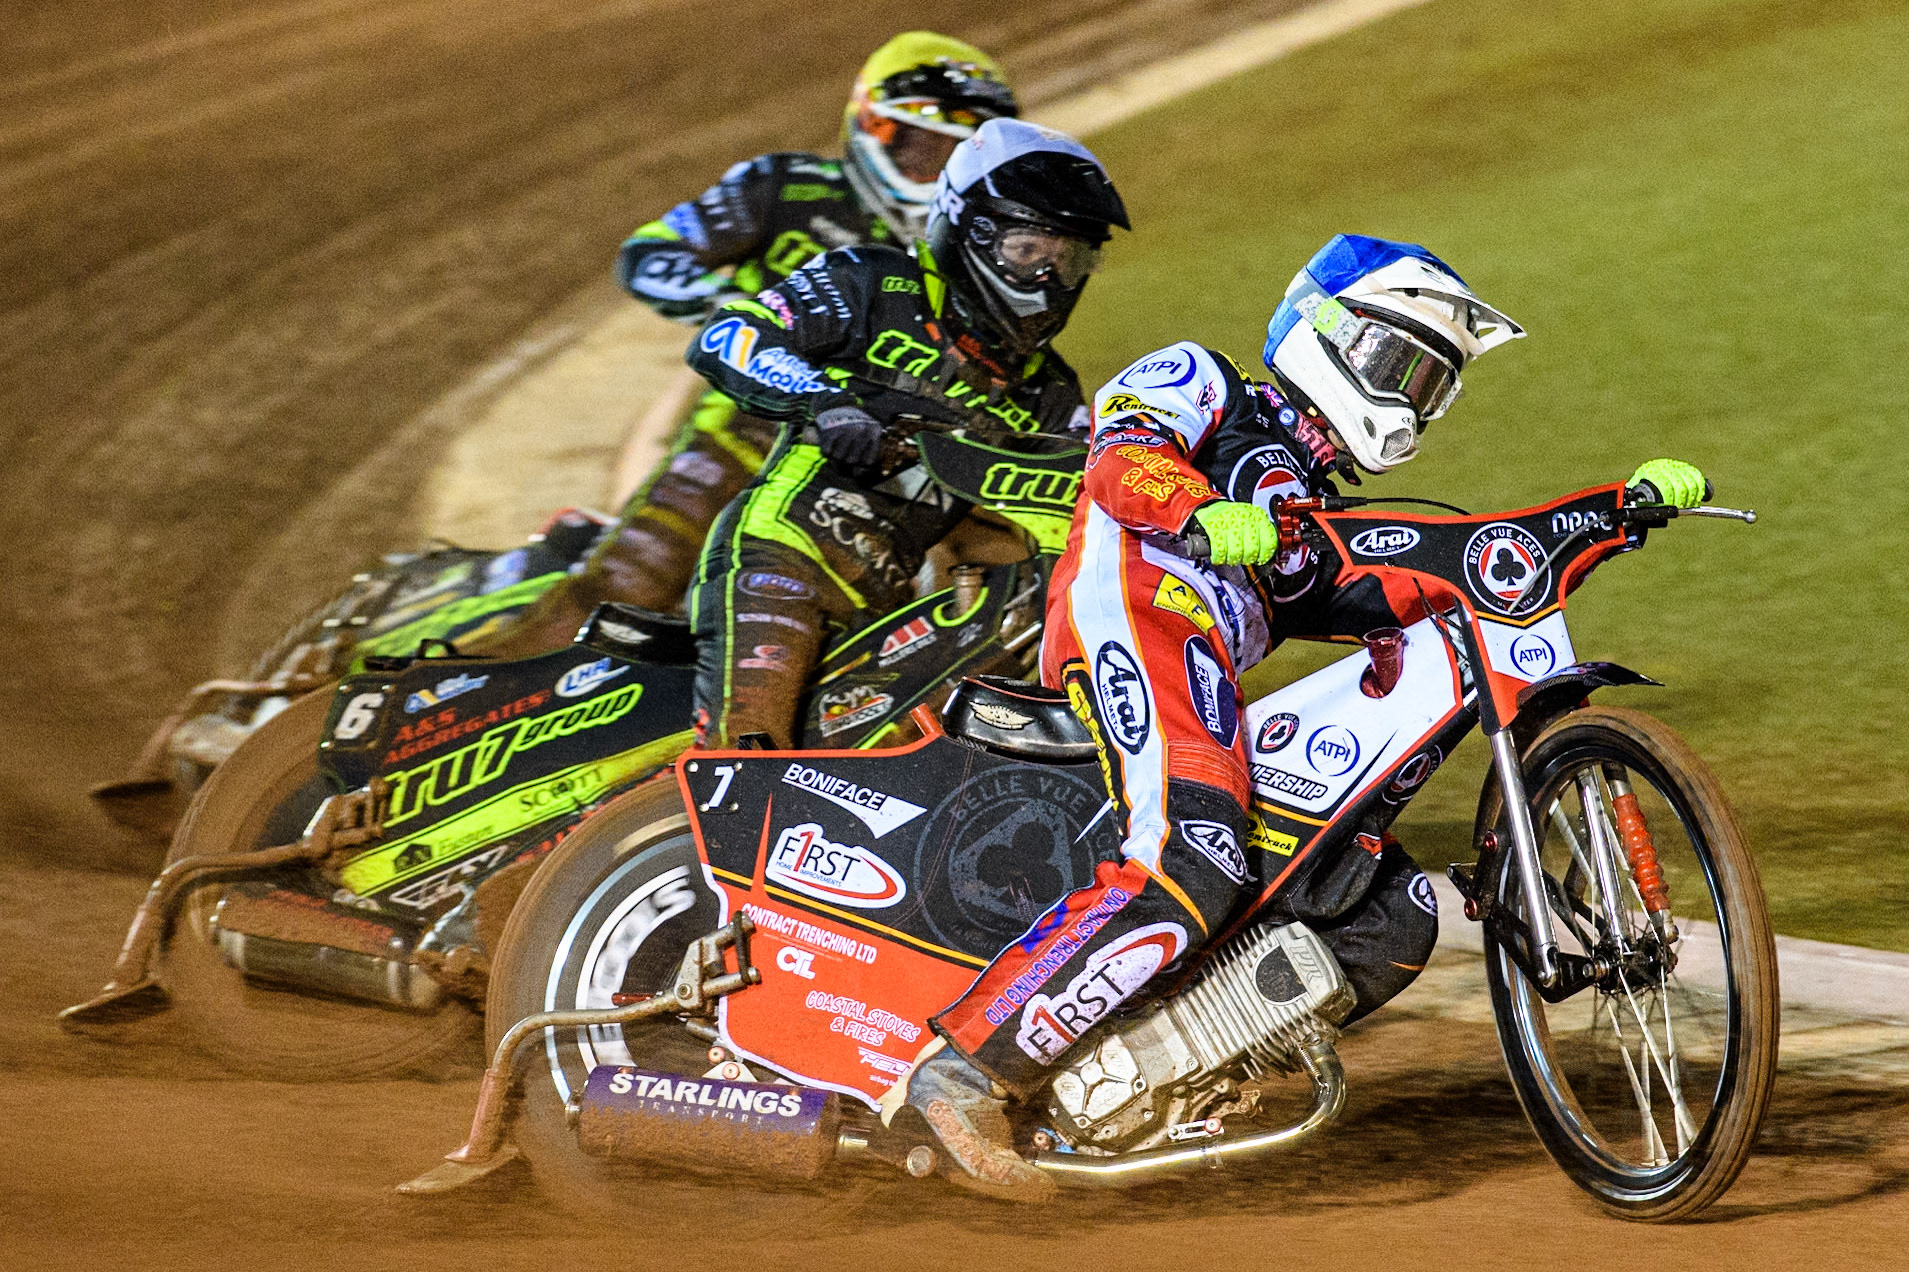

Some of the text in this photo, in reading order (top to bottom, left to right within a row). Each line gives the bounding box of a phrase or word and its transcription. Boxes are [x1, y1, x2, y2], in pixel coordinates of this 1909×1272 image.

[1130, 360, 1183, 377] ATPI
[1356, 529, 1412, 550] Arai
[1468, 528, 1541, 565] BELLE VUE ACES
[1518, 646, 1548, 664] ATPI
[334, 693, 385, 740] 6
[1100, 651, 1148, 740] Arai
[1314, 740, 1351, 762] ATPI
[708, 765, 735, 808] 1
[784, 763, 887, 811] BONIFACE
[951, 774, 1088, 822] BELLE VUE
[776, 861, 842, 888] HOME IMPROVEMENTS
[778, 830, 861, 882] F1RST
[741, 902, 877, 965] CONTRACT TRENCHING LTD
[1072, 886, 1134, 942] ONTRACT
[1005, 934, 1083, 1005] TRENCHING
[805, 989, 921, 1043] COASTAL STOVES
[830, 1017, 887, 1047] & FIRES
[984, 995, 1014, 1025] LTD
[1027, 963, 1125, 1058] F1RST
[608, 1073, 803, 1118] STARLINGS
